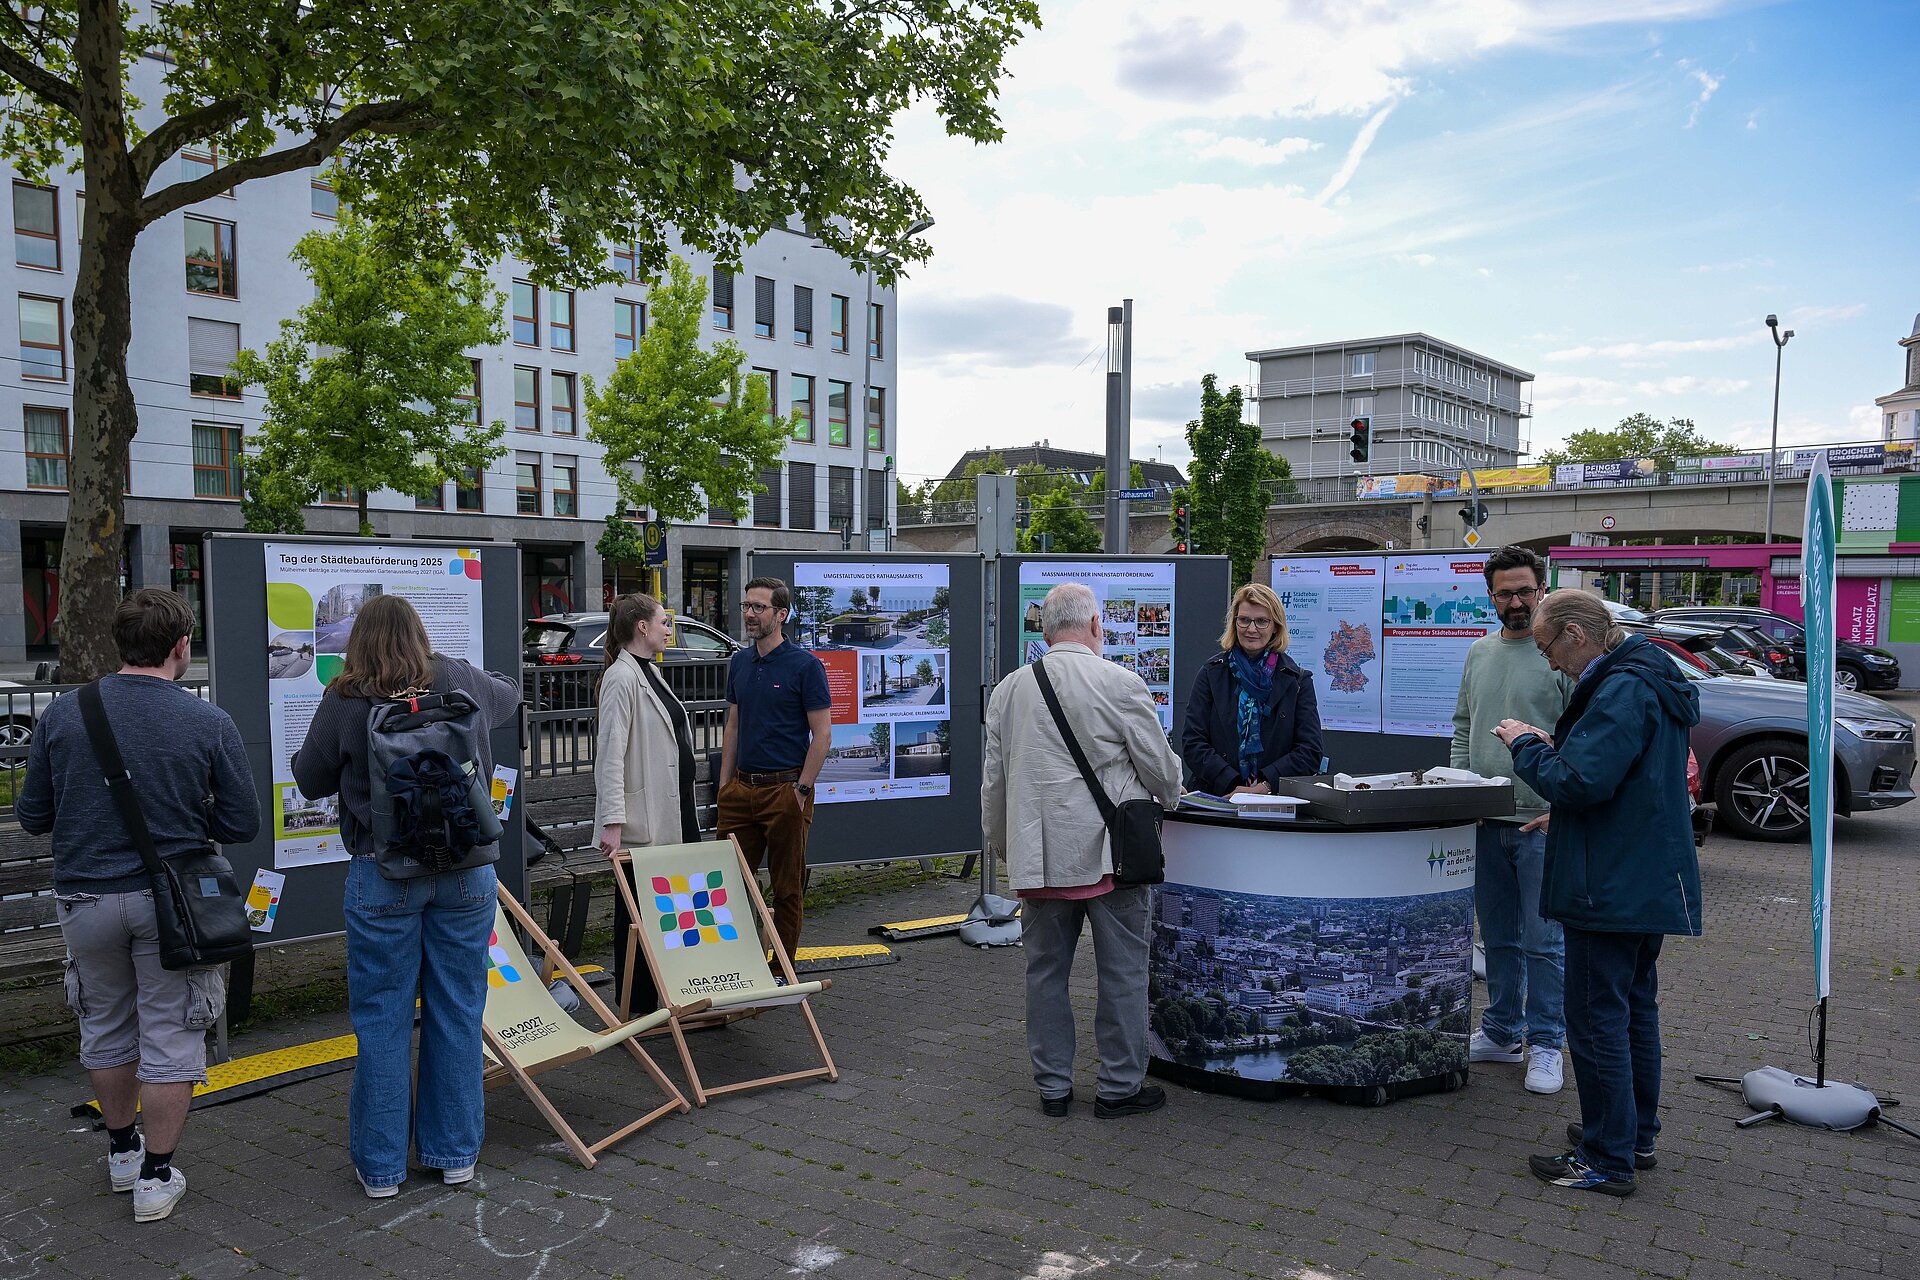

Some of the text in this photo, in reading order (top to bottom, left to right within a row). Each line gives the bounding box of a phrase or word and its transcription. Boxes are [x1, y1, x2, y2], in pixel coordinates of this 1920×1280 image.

[1829, 447, 1875, 456] BROICHER
[1829, 453, 1882, 461] SCHLOSSPARTY
[1676, 459, 1700, 467] KLIMA
[1585, 464, 1620, 472] PFINGST
[661, 527, 665, 537] 5
[279, 554, 443, 567] Tag der Städtebauförderung 2025
[1864, 584, 1878, 646] BLINGSPLATZ.
[1431, 629, 1484, 637] Städtebauförderung
[1447, 847, 1471, 858] Mülheim
[1455, 857, 1466, 865] der
[1446, 869, 1460, 877] Stadt
[688, 972, 740, 987] IGA 2027
[680, 979, 754, 995] RUHRGEBIET
[497, 1016, 543, 1040] IGA 2027
